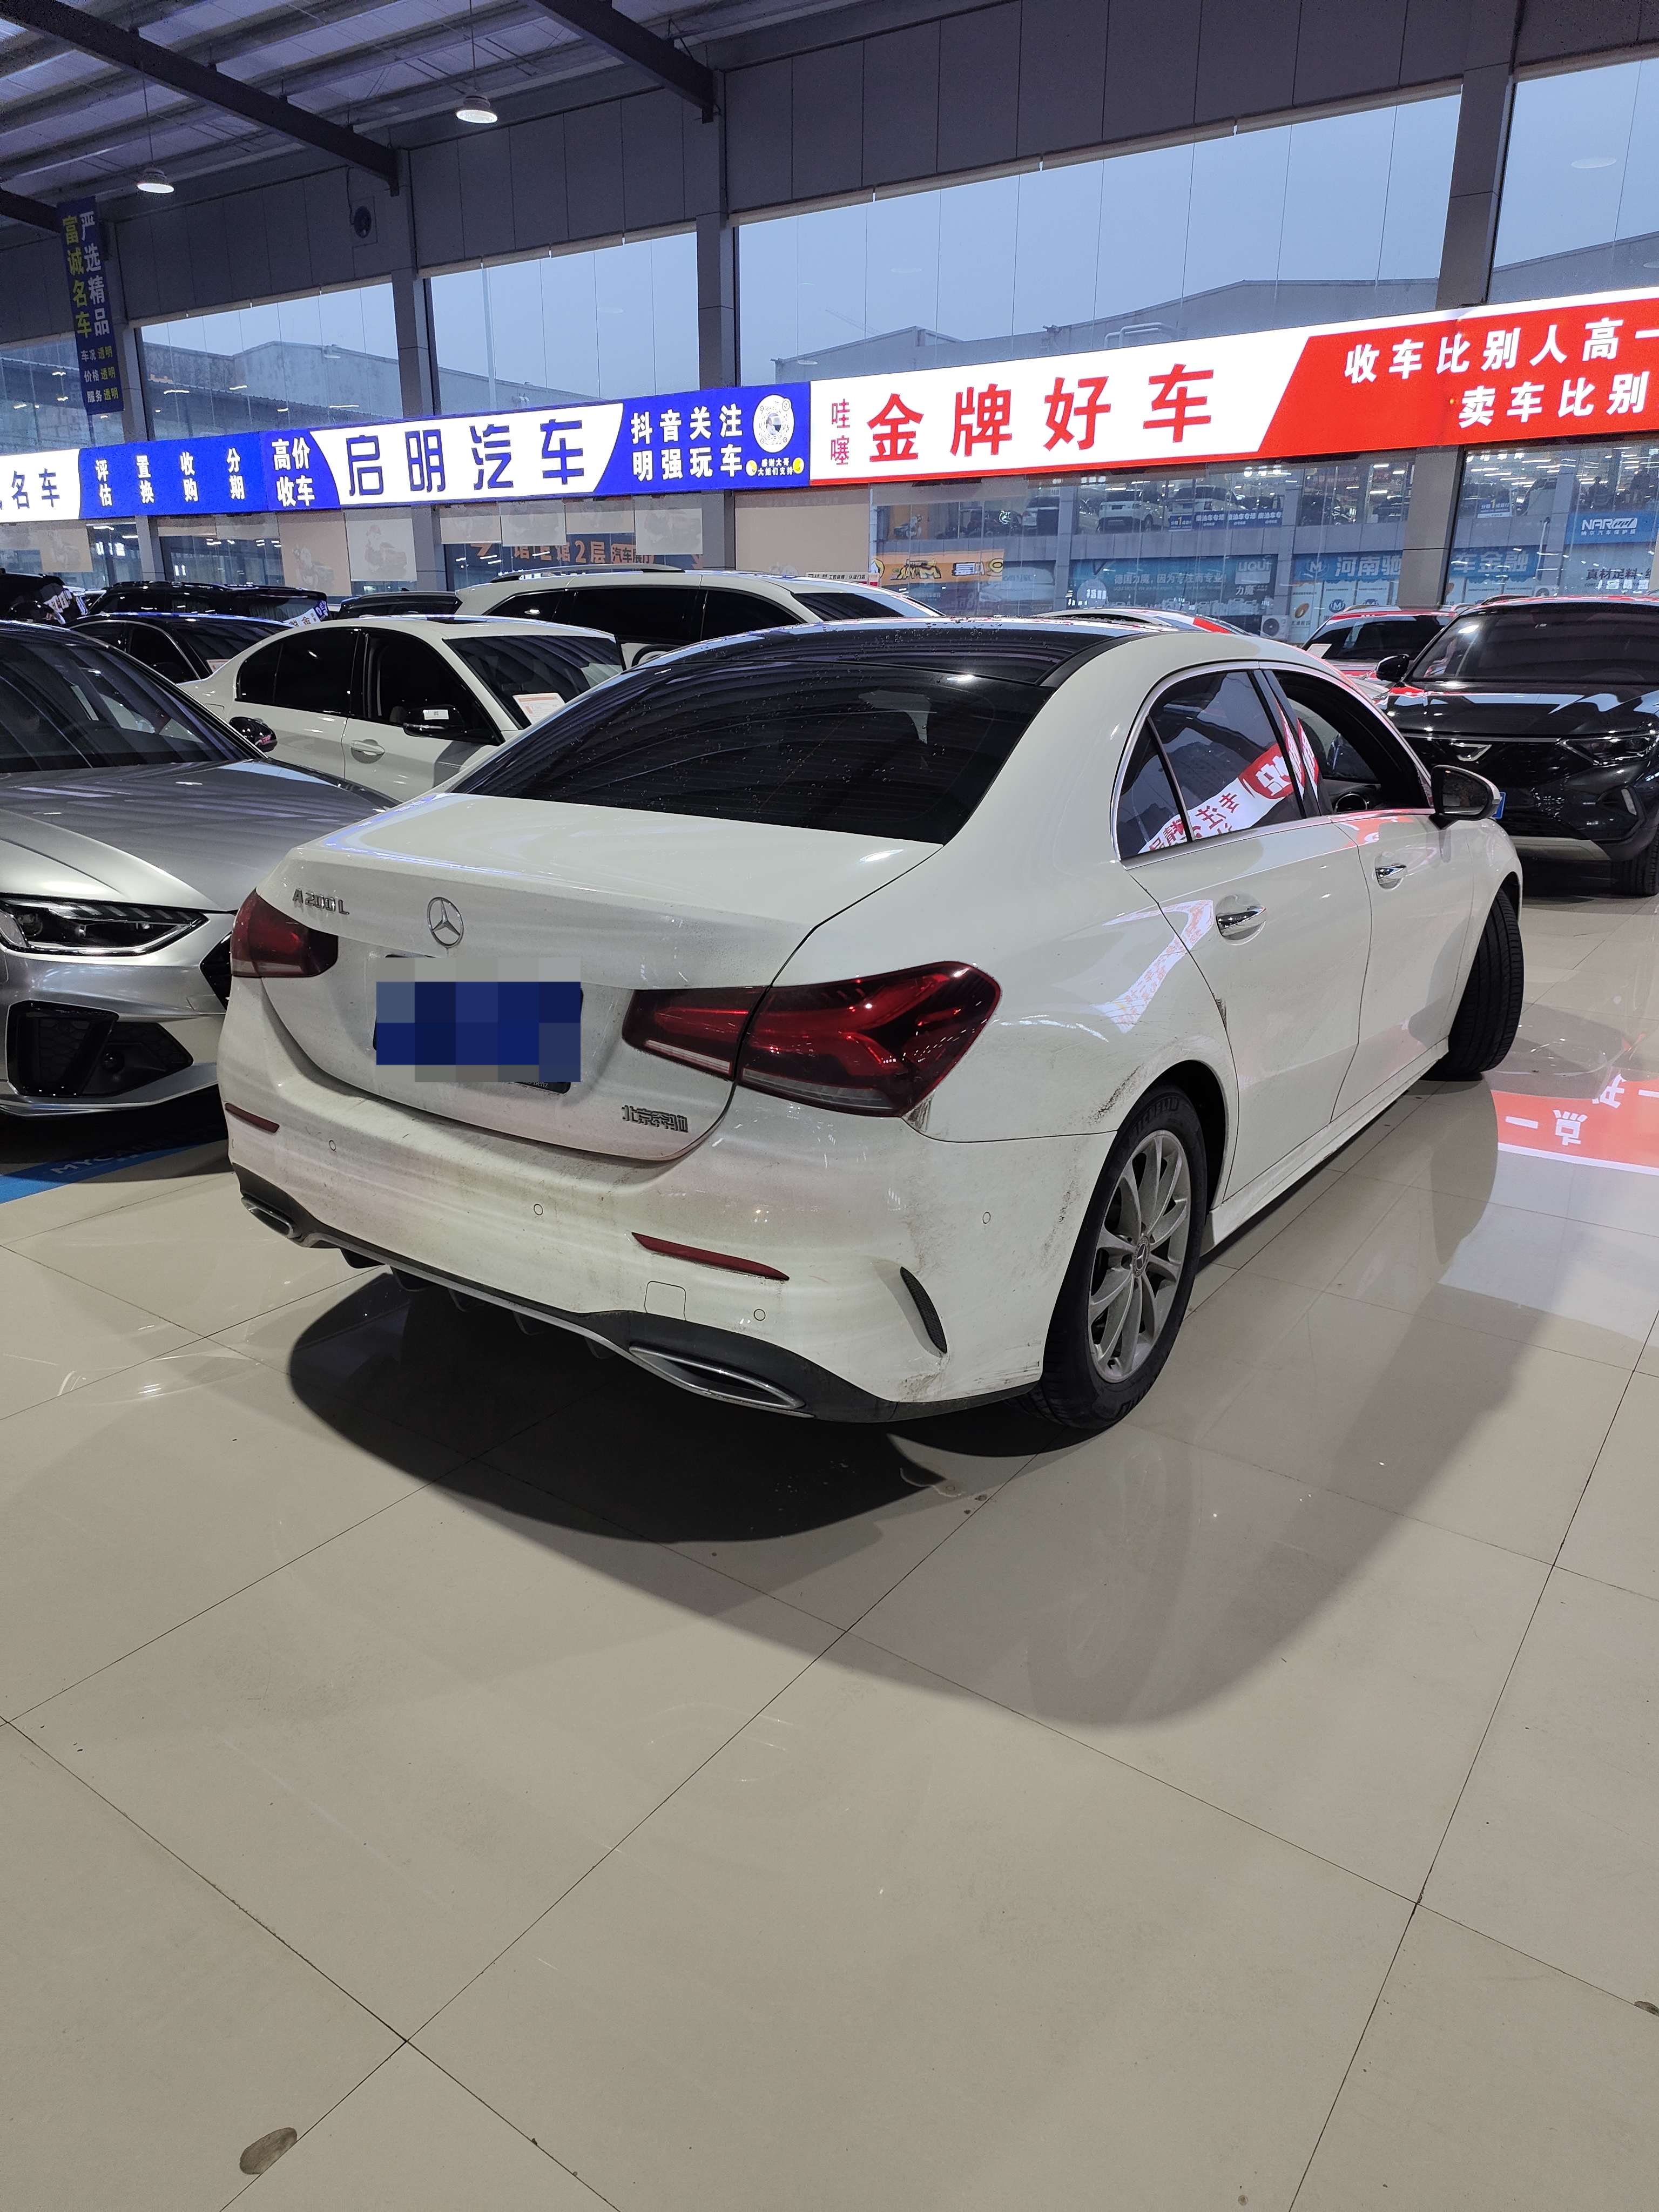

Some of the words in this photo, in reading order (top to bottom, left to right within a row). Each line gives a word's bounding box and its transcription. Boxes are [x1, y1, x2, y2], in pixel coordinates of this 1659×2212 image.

[62, 215, 92, 339] 富诚名车
[79, 211, 110, 336] 严选精品
[80, 346, 113, 362] 车况透明
[1344, 316, 1659, 384] 收车比别人高一
[84, 366, 116, 382] 价格透明
[87, 387, 119, 403] 服务透明
[866, 363, 1214, 462] 金牌好车
[630, 403, 743, 444] 抖音关注
[226, 448, 246, 500] 分期
[271, 437, 311, 471] 高价
[346, 419, 584, 497] 启明汽车
[632, 443, 743, 482] 明强玩车
[0, 468, 60, 510] 名车
[95, 459, 112, 507] 评估
[136, 455, 154, 504] 置换
[180, 451, 199, 502] 收购
[276, 476, 315, 507] 收车
[1238, 561, 1270, 571] LIQUI
[1235, 585, 1255, 596] 力魔
[622, 1105, 689, 1133] 北京奔驰
